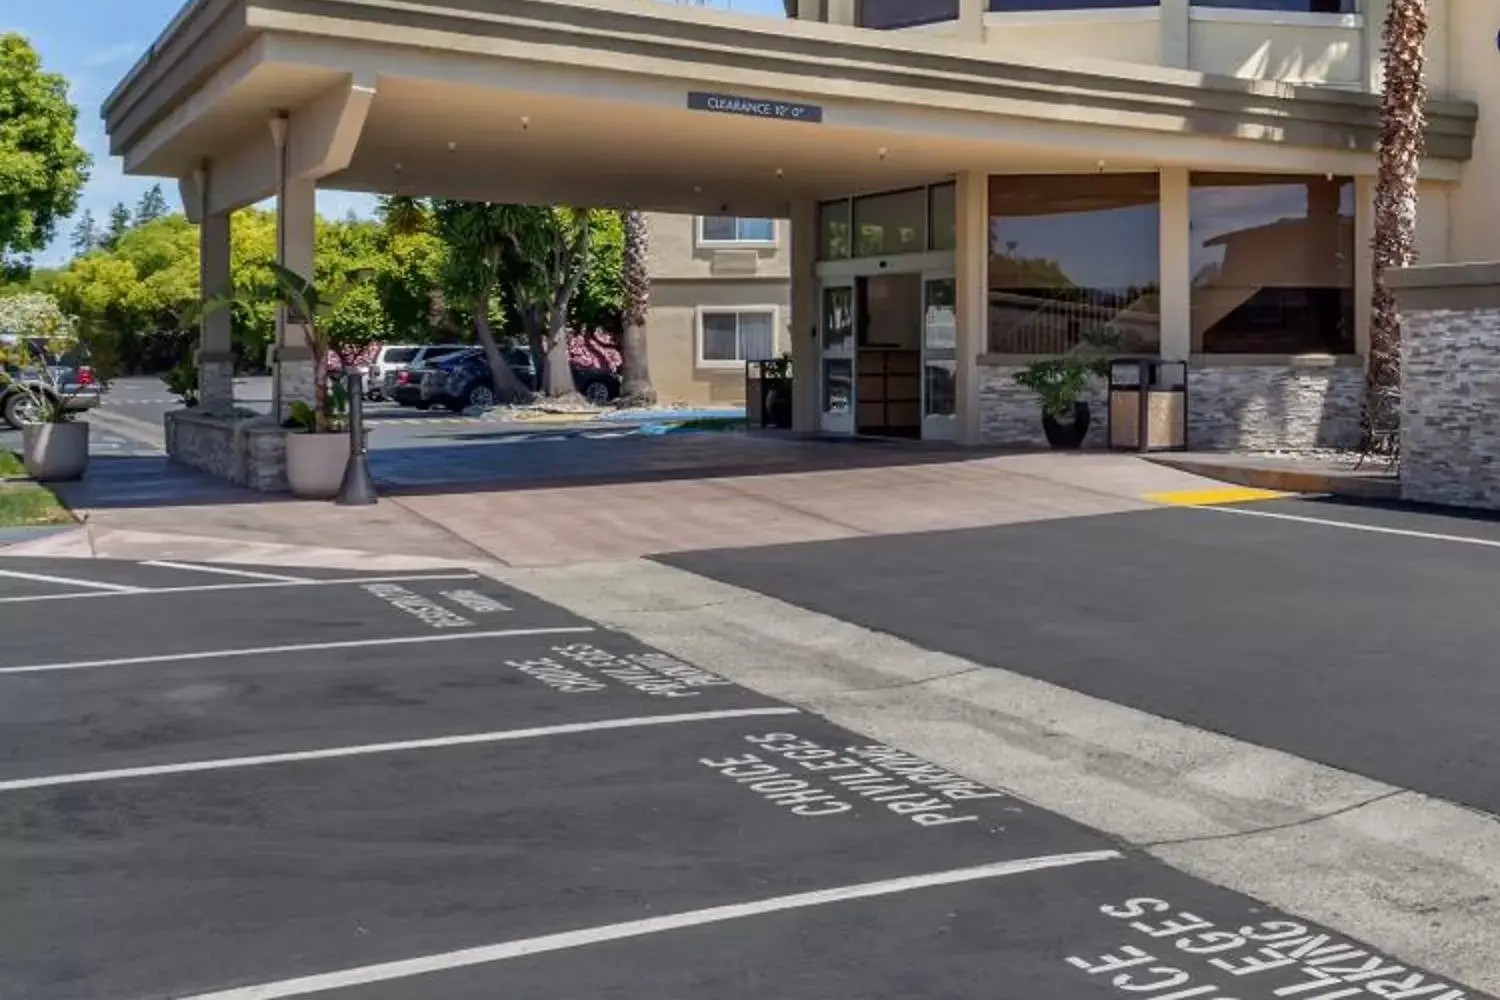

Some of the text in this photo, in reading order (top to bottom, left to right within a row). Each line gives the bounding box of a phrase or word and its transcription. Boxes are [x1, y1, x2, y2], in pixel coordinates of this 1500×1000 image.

[706, 96, 773, 116] CLEARANCE
[699, 753, 852, 816] CHOICE
[744, 732, 979, 826] PRIVILEGES
[1064, 945, 1240, 1000] ICE
[1099, 897, 1365, 1000] ILEGES
[1239, 920, 1466, 1000] RKING
